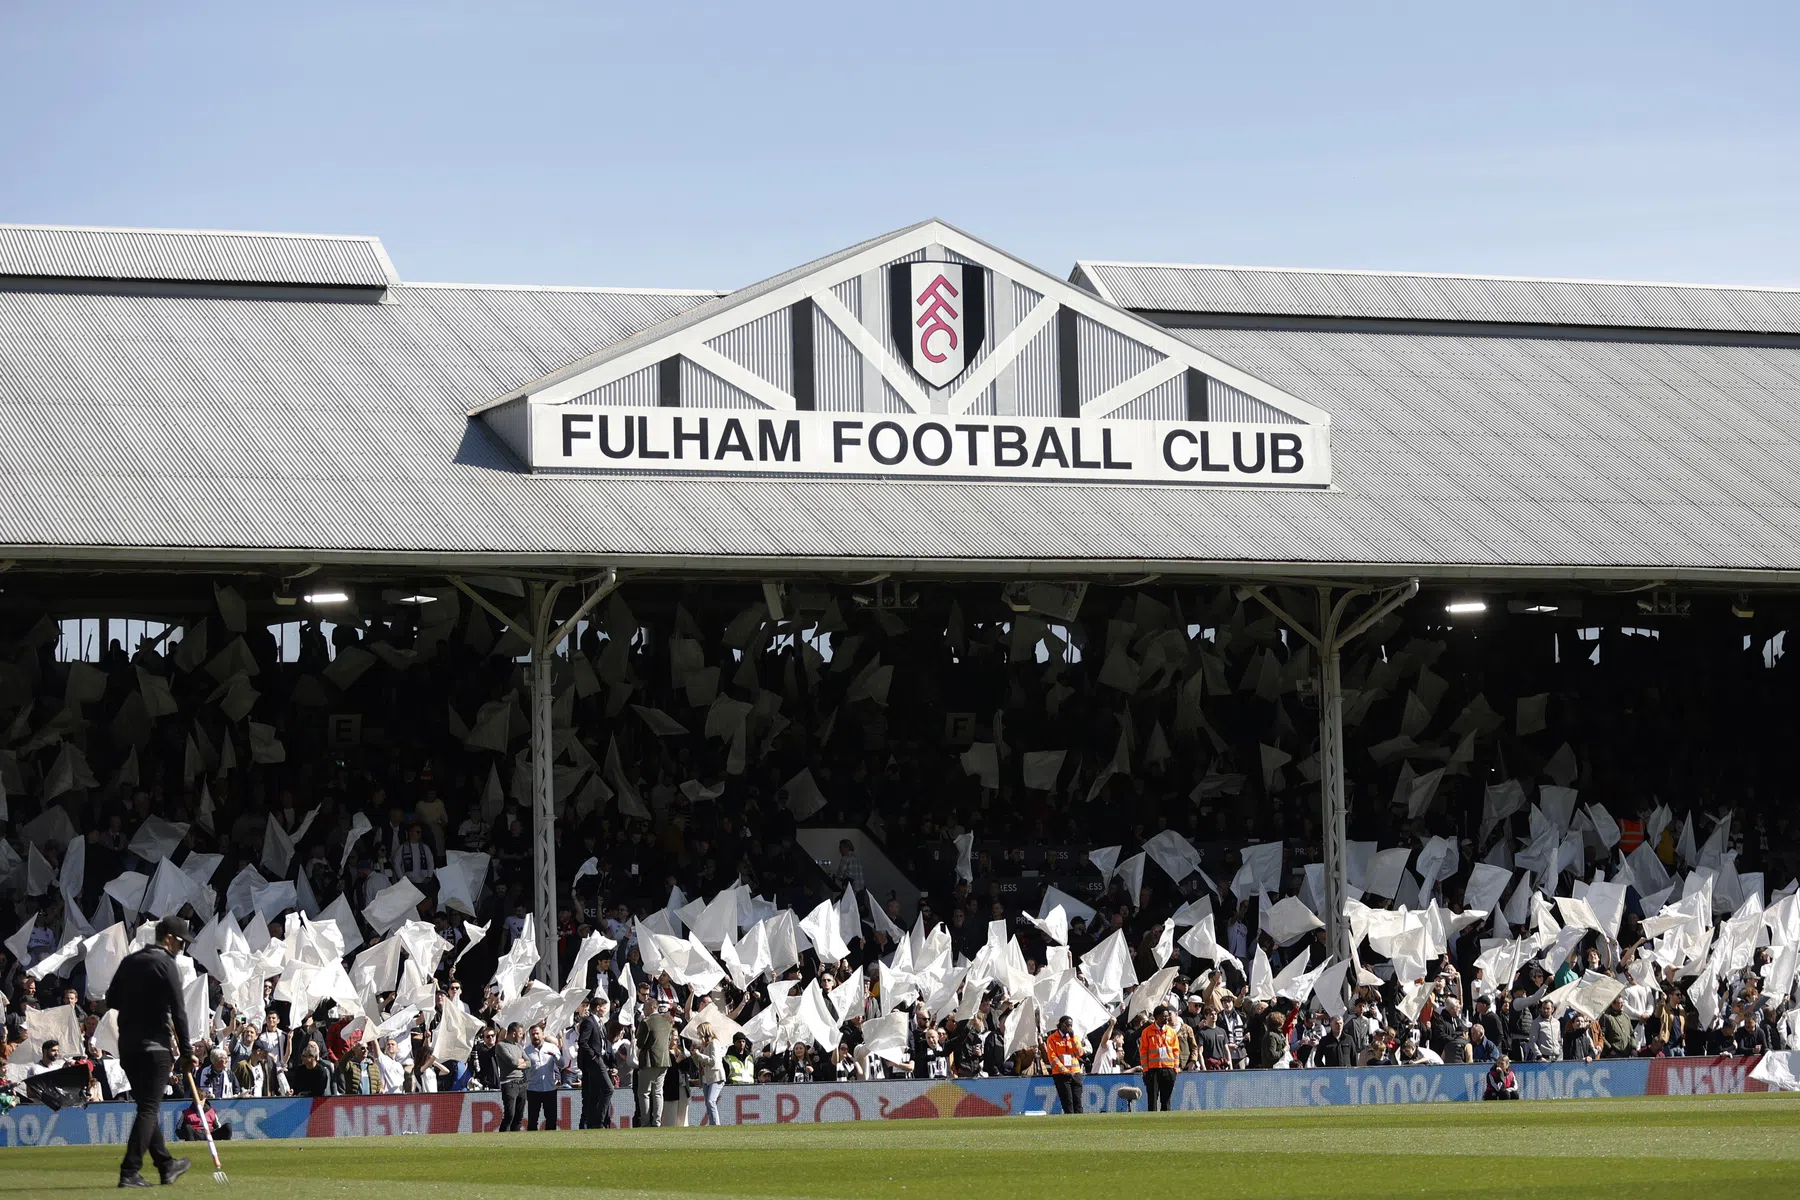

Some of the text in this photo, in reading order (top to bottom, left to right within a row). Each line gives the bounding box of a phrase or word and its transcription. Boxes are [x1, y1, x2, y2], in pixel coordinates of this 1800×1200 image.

[562, 413, 1304, 474] FULHAM FOOTBALL CLUB
[336, 719, 352, 742] E
[952, 718, 969, 738] F
[1345, 1073, 1449, 1104] 100%
[1667, 1065, 1748, 1095] NEW
[333, 1103, 431, 1137] NEW
